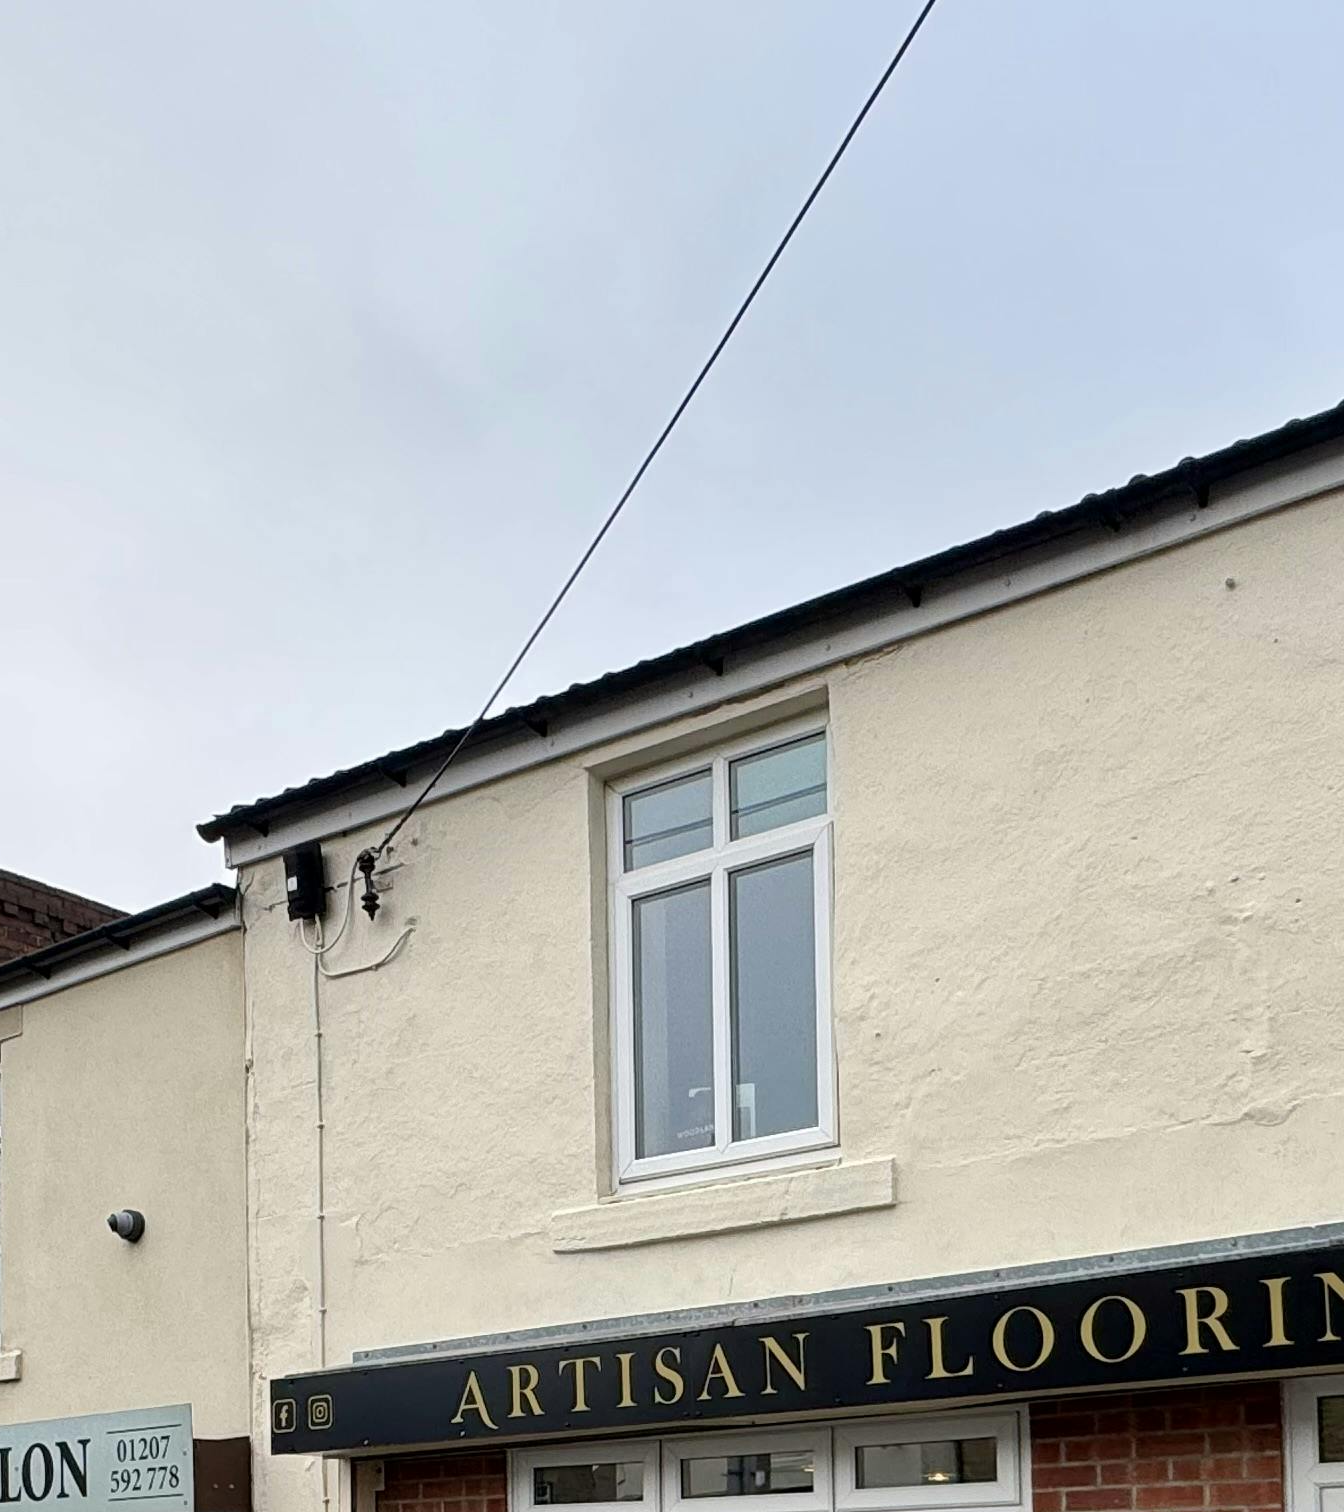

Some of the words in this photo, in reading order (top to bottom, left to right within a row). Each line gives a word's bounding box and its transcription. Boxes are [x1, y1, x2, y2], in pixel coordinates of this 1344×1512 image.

[451, 1332, 811, 1430] ARTISAN
[117, 1435, 171, 1463] 01207
[110, 1468, 142, 1494] 592
[146, 1464, 180, 1491] 778
